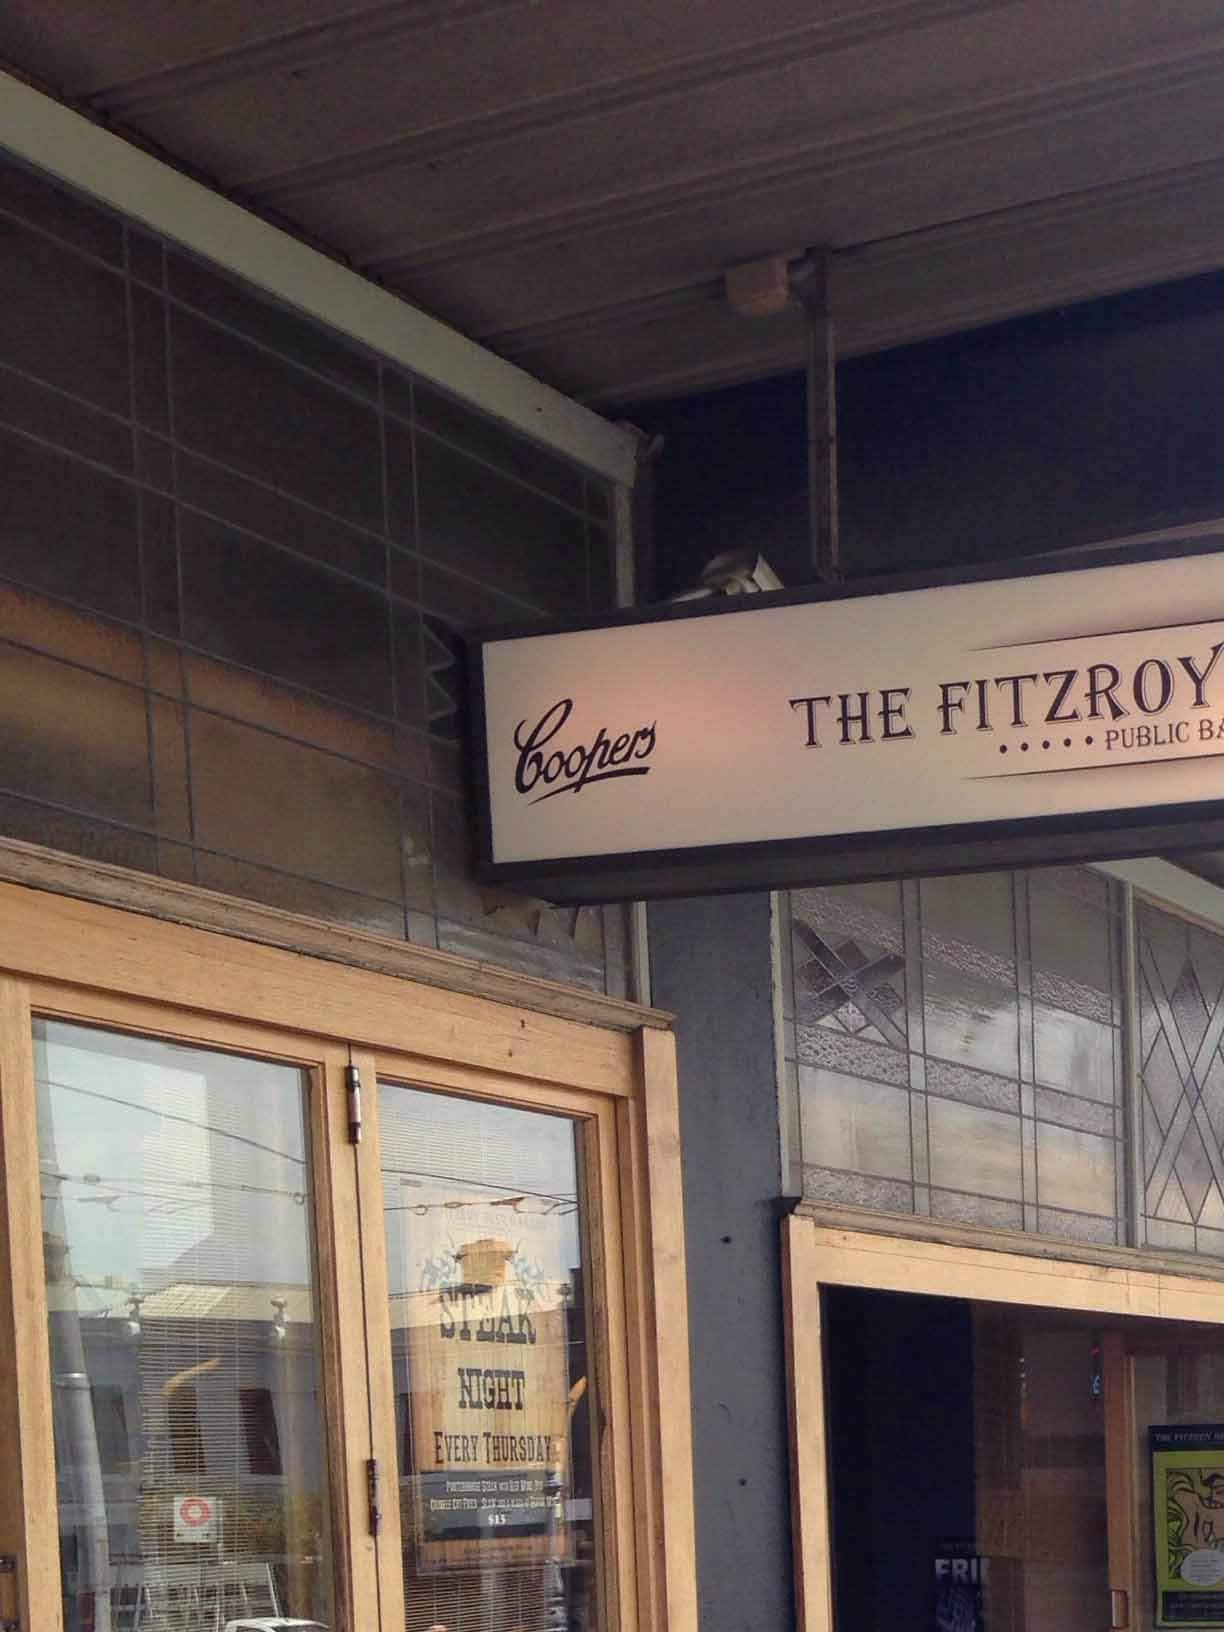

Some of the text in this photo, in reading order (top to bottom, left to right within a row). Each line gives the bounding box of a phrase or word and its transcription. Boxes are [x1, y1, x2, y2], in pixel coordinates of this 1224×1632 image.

[790, 687, 914, 749] THE
[1106, 720, 1190, 750] PUBLIC
[513, 698, 657, 806] Coopers
[457, 1367, 526, 1411] NIGHT
[433, 1430, 479, 1465] EVERY
